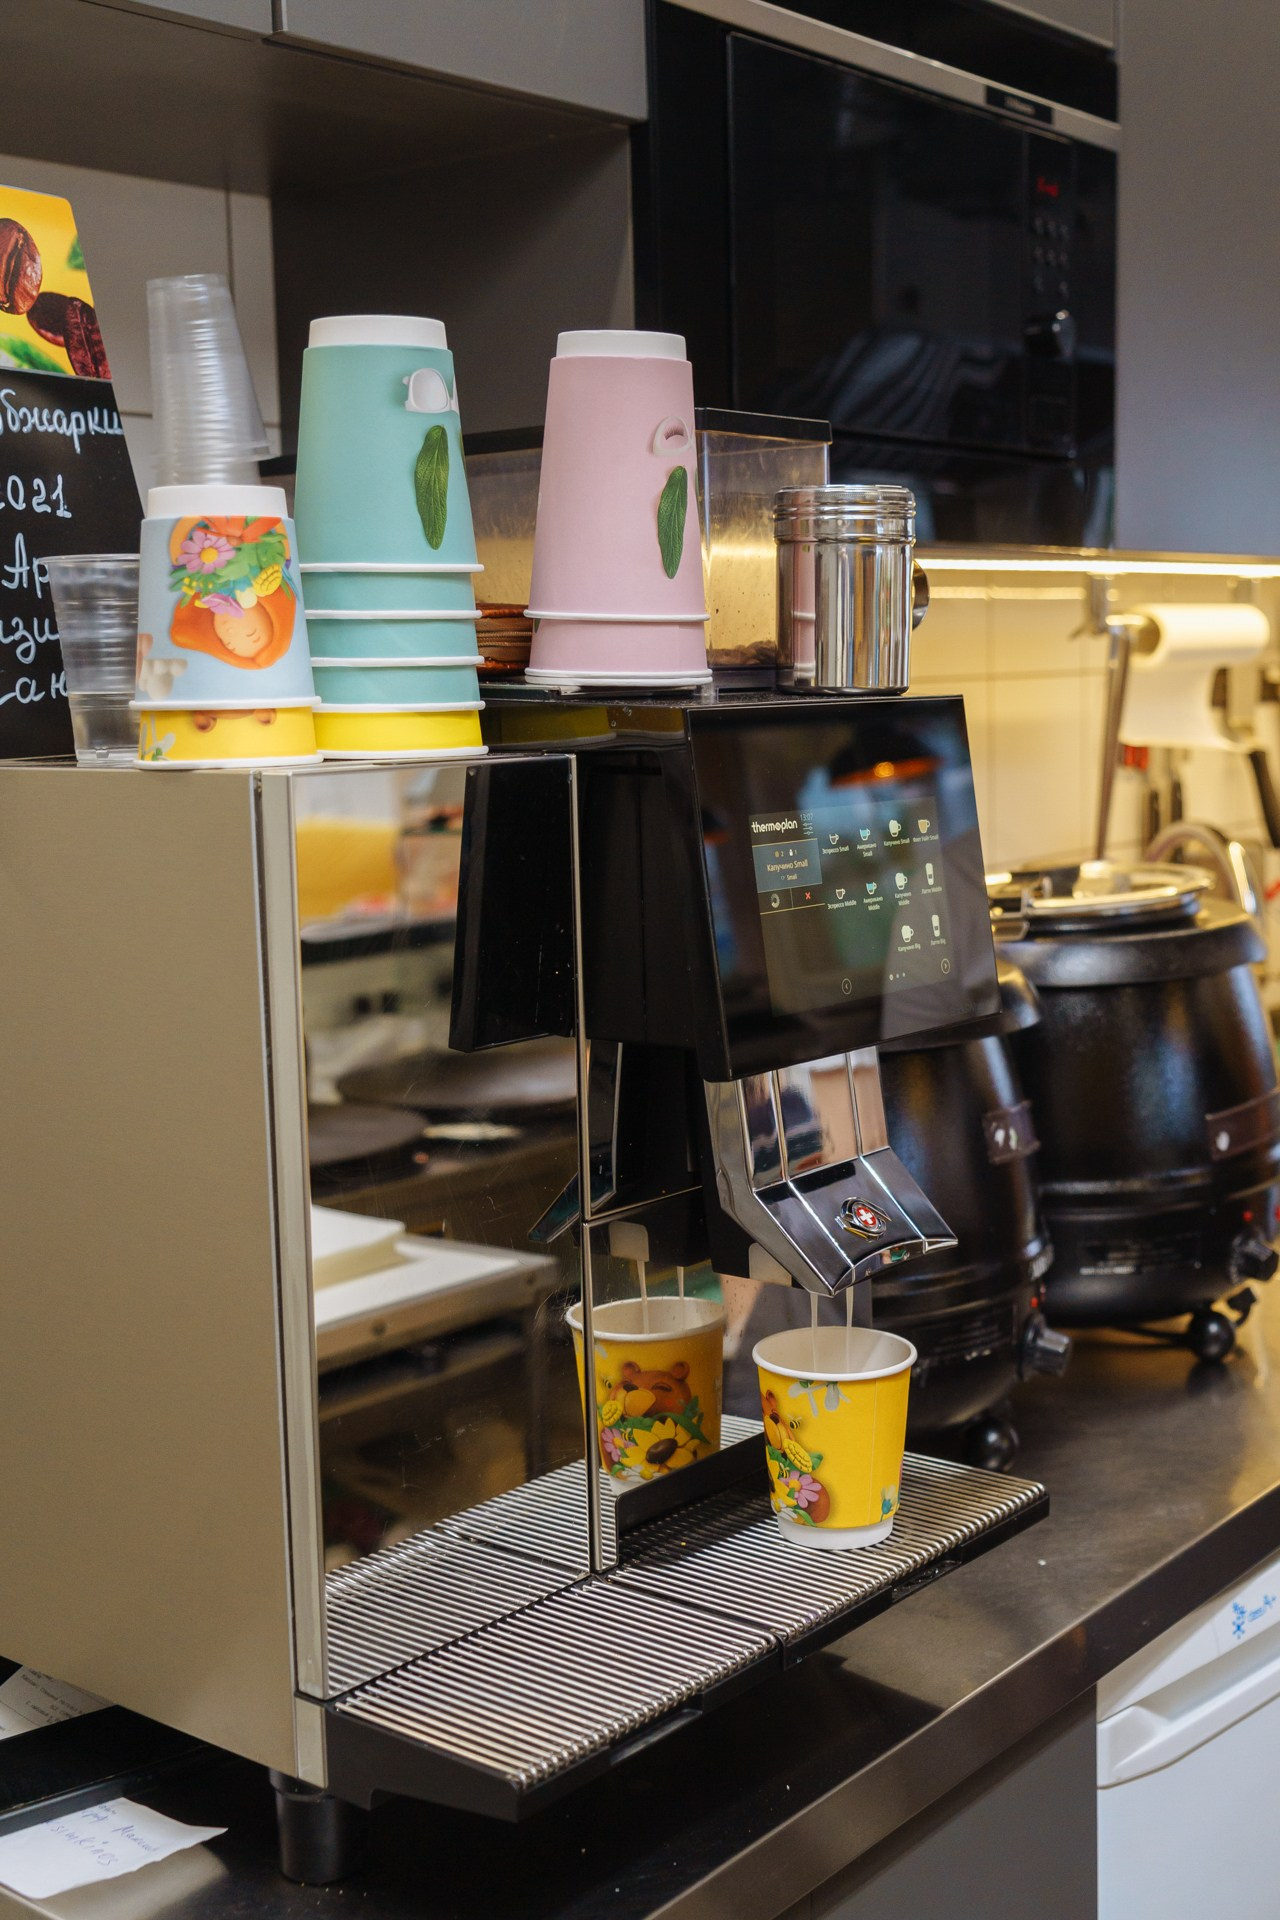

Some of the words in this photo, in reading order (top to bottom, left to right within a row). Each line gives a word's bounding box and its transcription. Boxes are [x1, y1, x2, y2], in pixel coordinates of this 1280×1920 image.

[0, 388, 124, 454] бжарки
[0, 474, 72, 518] 021
[751, 818, 798, 833] thermoplan
[767, 863, 793, 873] Капучино
[794, 859, 808, 868] Small
